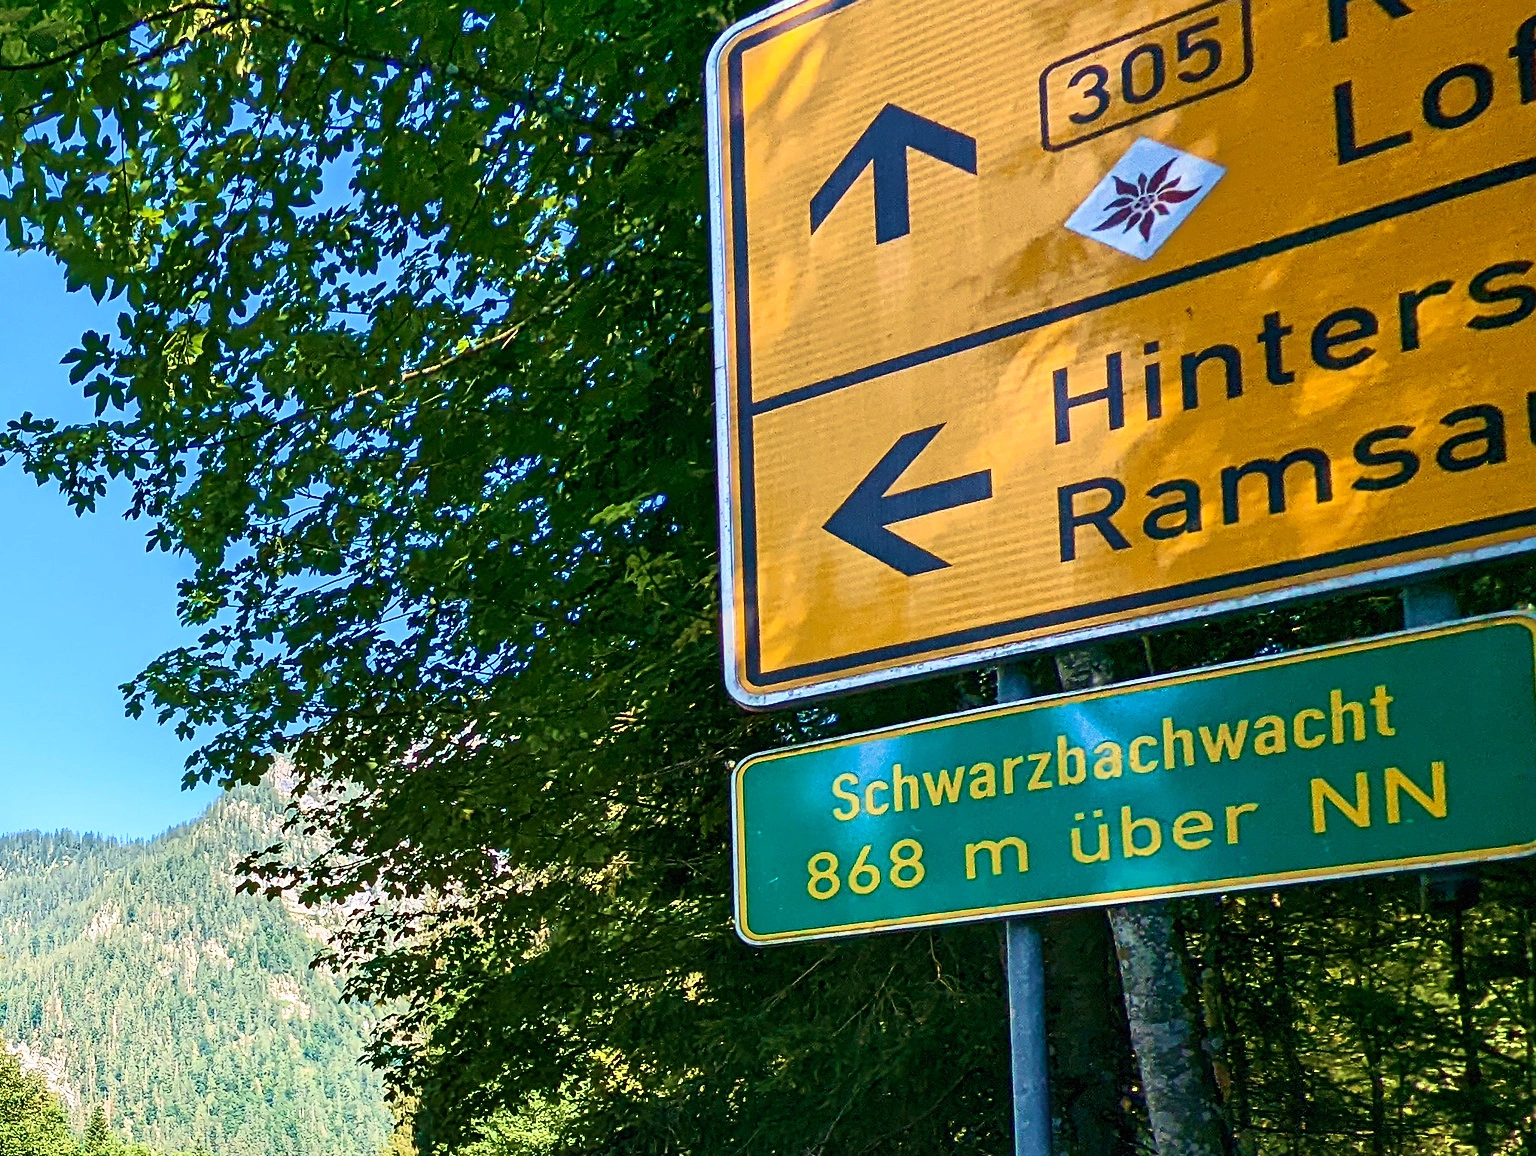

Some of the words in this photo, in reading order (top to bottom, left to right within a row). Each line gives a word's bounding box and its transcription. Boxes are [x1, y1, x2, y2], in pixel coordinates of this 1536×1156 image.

[1068, 17, 1224, 126] 305
[1052, 260, 1536, 446] Hinters
[1056, 390, 1536, 564] Ramsa
[831, 683, 1397, 822] Schwarzbachwacht
[807, 838, 926, 902] 868
[965, 834, 1030, 882] m
[1070, 802, 1260, 866] über
[1310, 760, 1449, 836] NN
